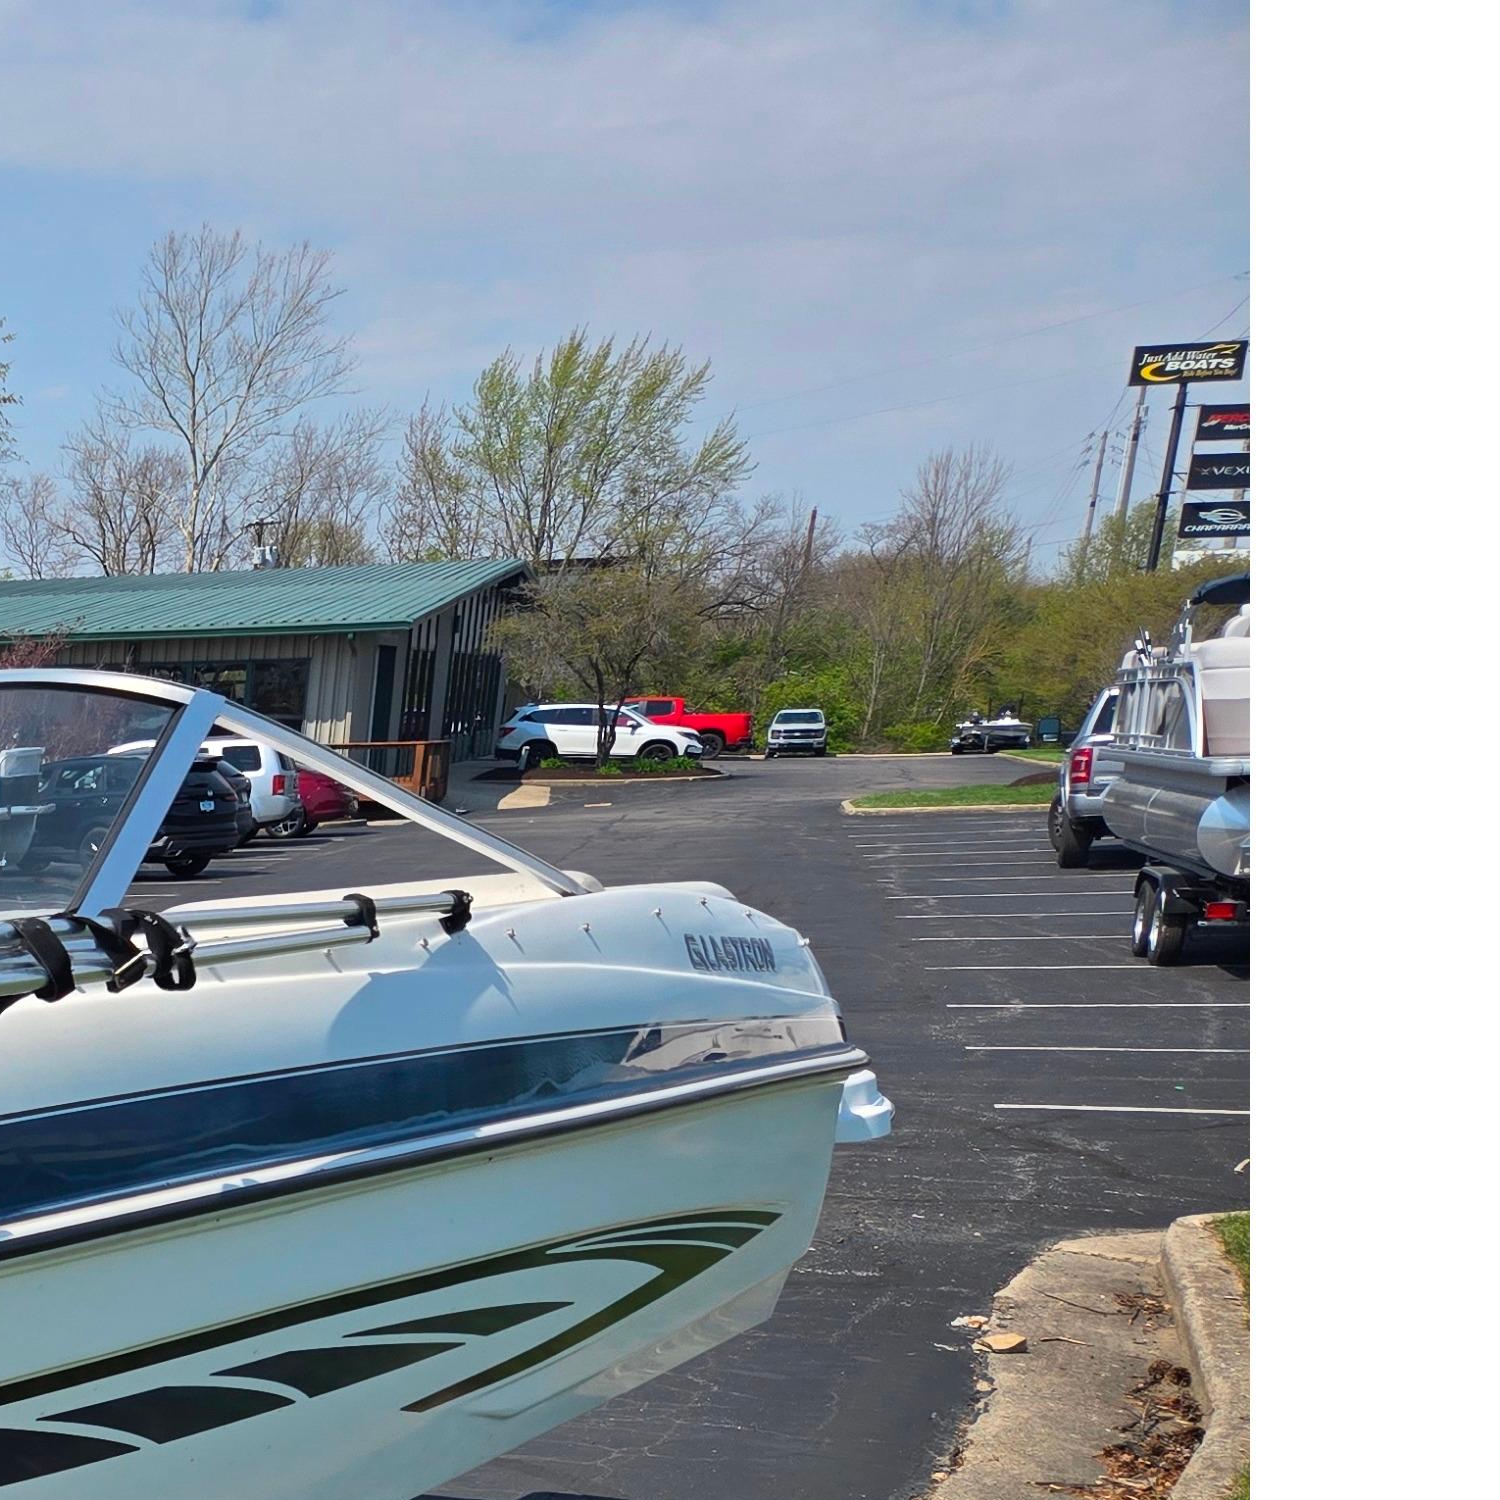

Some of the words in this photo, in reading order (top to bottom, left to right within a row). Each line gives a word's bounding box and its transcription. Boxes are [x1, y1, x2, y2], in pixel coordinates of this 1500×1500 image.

[1138, 353, 1163, 366] Just
[1163, 350, 1184, 361] Add
[1186, 350, 1217, 361] Water
[1164, 358, 1236, 372] BOATS
[683, 933, 777, 973] GLASTRON
